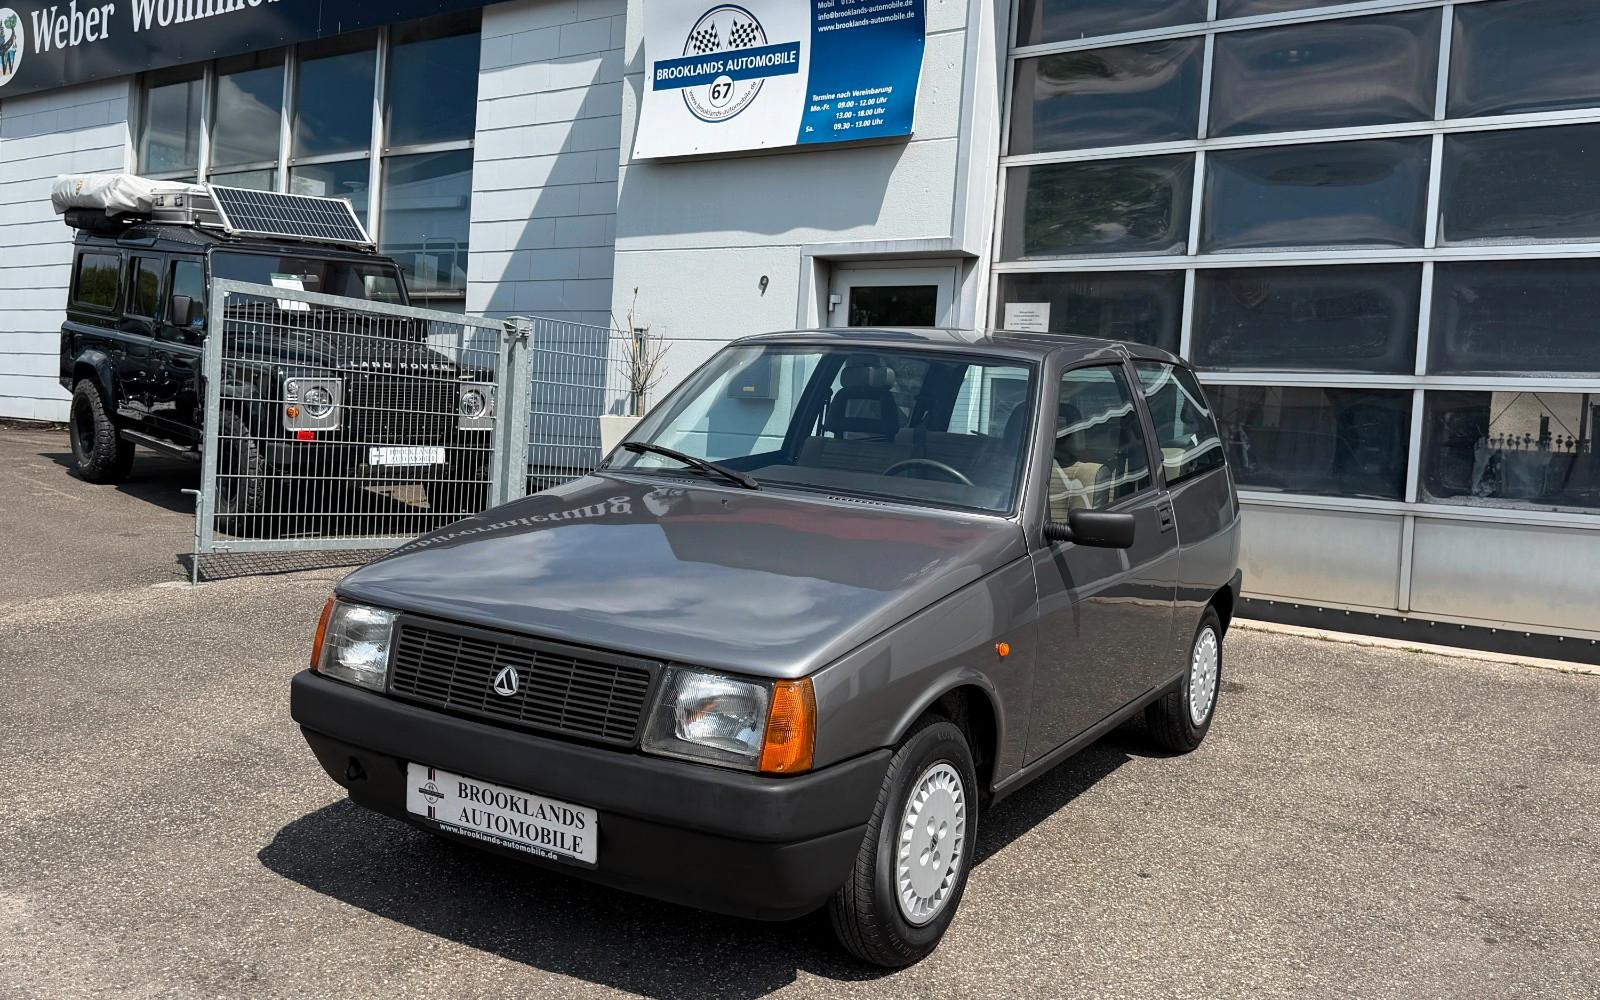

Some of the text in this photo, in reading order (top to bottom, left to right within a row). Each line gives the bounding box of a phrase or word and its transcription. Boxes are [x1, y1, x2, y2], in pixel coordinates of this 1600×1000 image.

[817, 0, 835, 9] Mobil
[817, 0, 913, 21] info@brooklands-automobile.de
[31, 0, 114, 54] Weber
[817, 11, 915, 32] www.brooklands-automobile.de
[656, 50, 797, 81] BROOKLANDS AUTOMOBILE
[711, 82, 732, 100] 67
[812, 85, 893, 102] Termine nach Vereinbarung
[836, 111, 852, 119] 13.00
[857, 109, 873, 117] 18.00
[874, 107, 885, 115] Uhr
[837, 101, 854, 109] 09.00
[859, 98, 875, 107] 12.00
[805, 125, 814, 133] Sa.
[833, 122, 850, 131] 09.30
[855, 120, 871, 128] 13.00
[872, 118, 883, 126] Uhr
[760, 275, 769, 297] 9
[400, 362, 449, 370] ROVER
[457, 781, 586, 830] BROOKLANDS
[458, 806, 584, 855] AUTOMOBILE
[439, 822, 558, 861] www.brooklands-automobile.de
